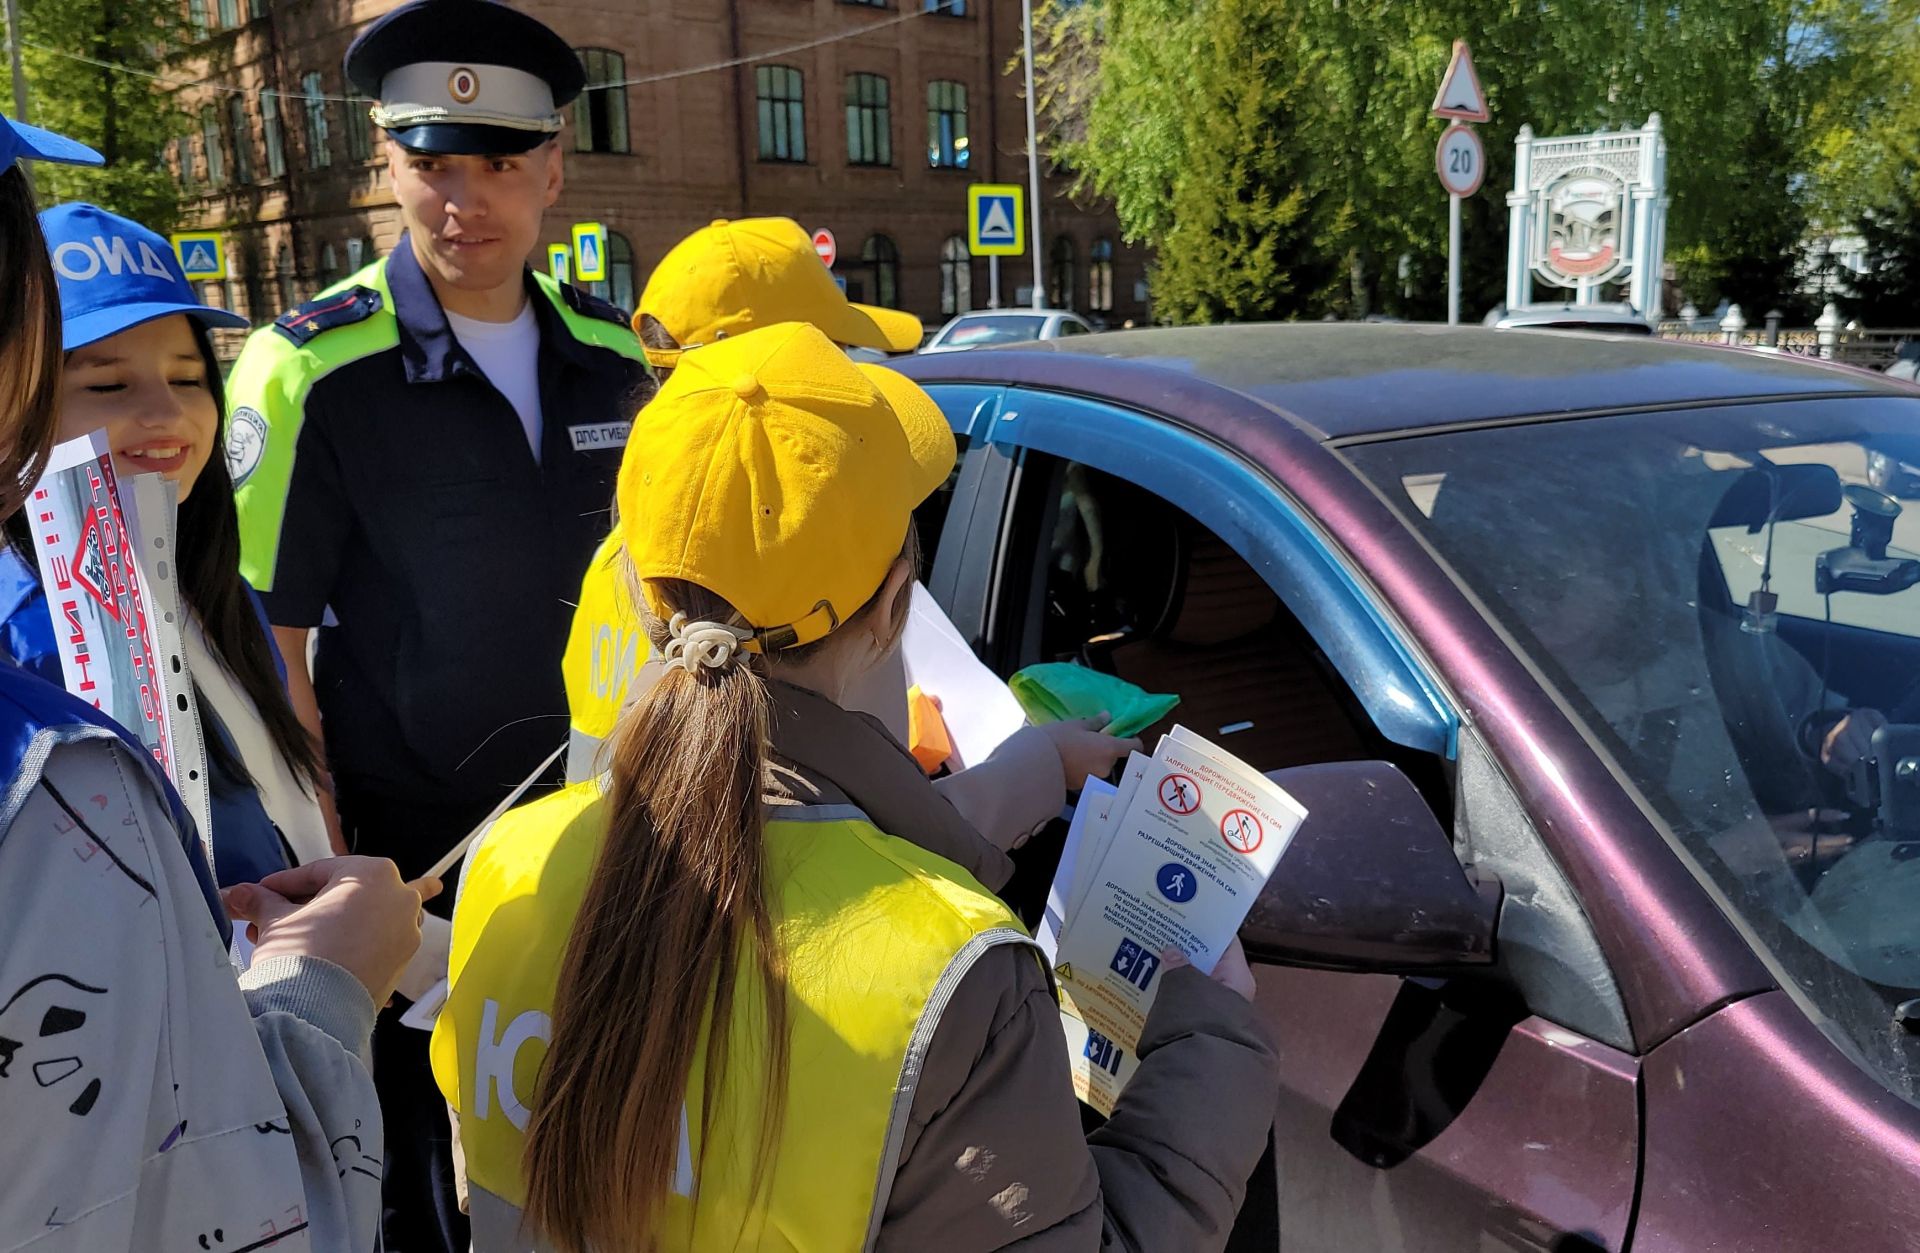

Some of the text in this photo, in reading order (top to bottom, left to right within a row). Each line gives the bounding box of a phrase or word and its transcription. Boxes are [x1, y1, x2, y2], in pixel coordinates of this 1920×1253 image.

[1450, 149, 1471, 174] 20
[575, 429, 599, 446] ДПС
[103, 463, 143, 614] ДВАЖДЫ
[86, 466, 155, 722] ОТКРЫТ
[1164, 755, 1214, 786] ЗАПРЕЩАЮЩИЕ
[1212, 781, 1261, 815] ПЕРЕДВИЖЕНИЕ
[1260, 811, 1269, 820] НА
[1268, 818, 1282, 830] СИМ
[1199, 764, 1235, 788] ДОРОЖНЫЕ
[1137, 830, 1237, 896] РАЗРЕШАЮЩИЙ ДВИЖЕНИЕ НА СИМ
[1164, 837, 1201, 860] ДОРОЖНЫЙ
[1102, 913, 1124, 929] ПОТОКУ
[1104, 905, 1143, 932] ВЫДЕЛЕННОЙ
[1142, 928, 1165, 945] ПОЛОСЕ
[1105, 881, 1140, 903] ДОРОЖНЫЙ
[1139, 901, 1156, 913] ЗНАК
[1155, 910, 1191, 936] ОБОЗНАЧАЕТ
[1112, 893, 1122, 902] ПО
[1122, 899, 1148, 917] КОТОРОЙ
[1147, 914, 1179, 937] ДВИЖЕНИЕ
[1178, 934, 1188, 944] НА
[1113, 902, 1147, 926] РАЗРЕШЕНО
[1146, 923, 1156, 931] ПО
